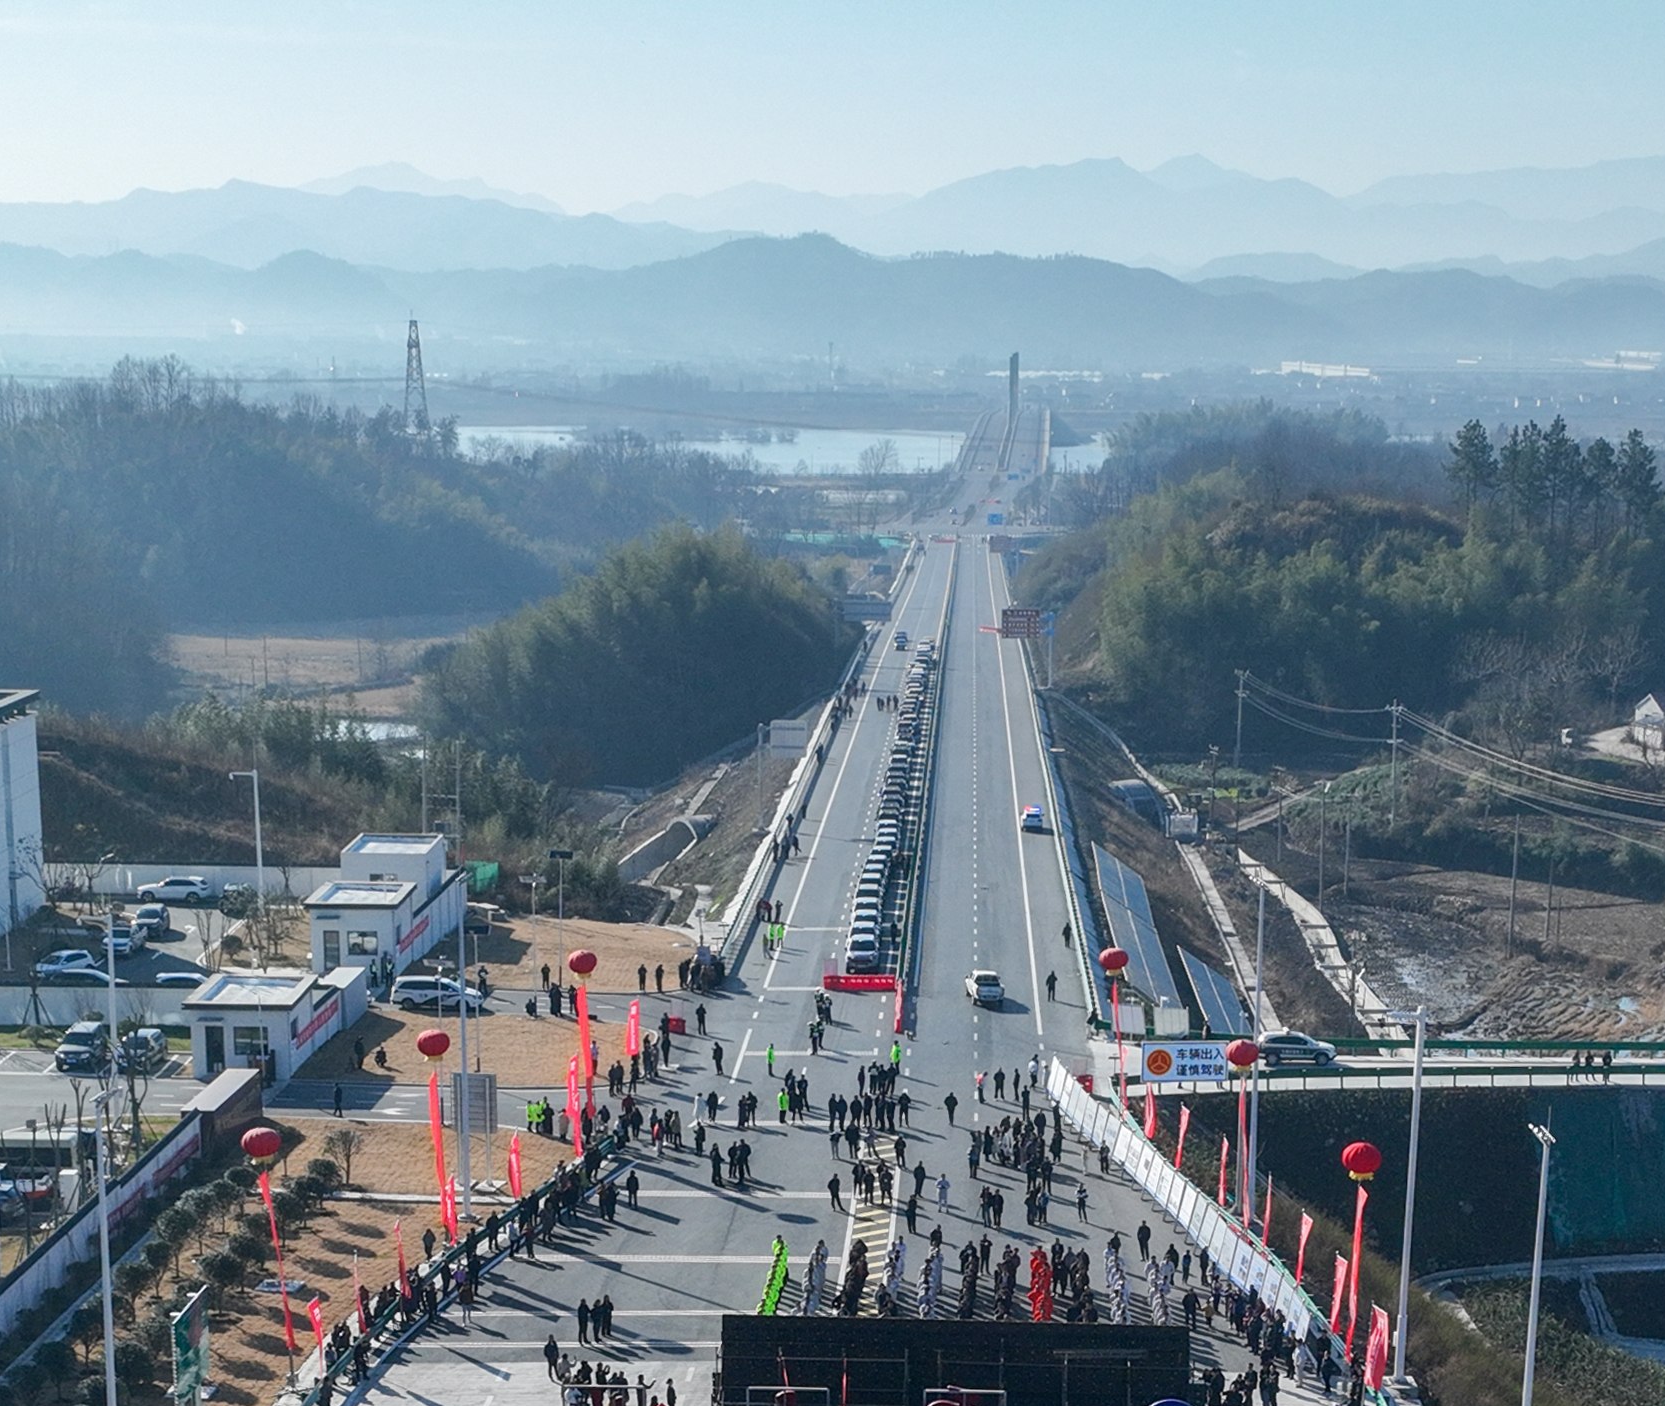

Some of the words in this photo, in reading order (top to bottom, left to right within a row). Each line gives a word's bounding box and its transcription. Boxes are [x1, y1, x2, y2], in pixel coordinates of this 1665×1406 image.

[1175, 1047, 1225, 1062] 车辆出入
[1175, 1064, 1225, 1077] 谨慎驾驶
